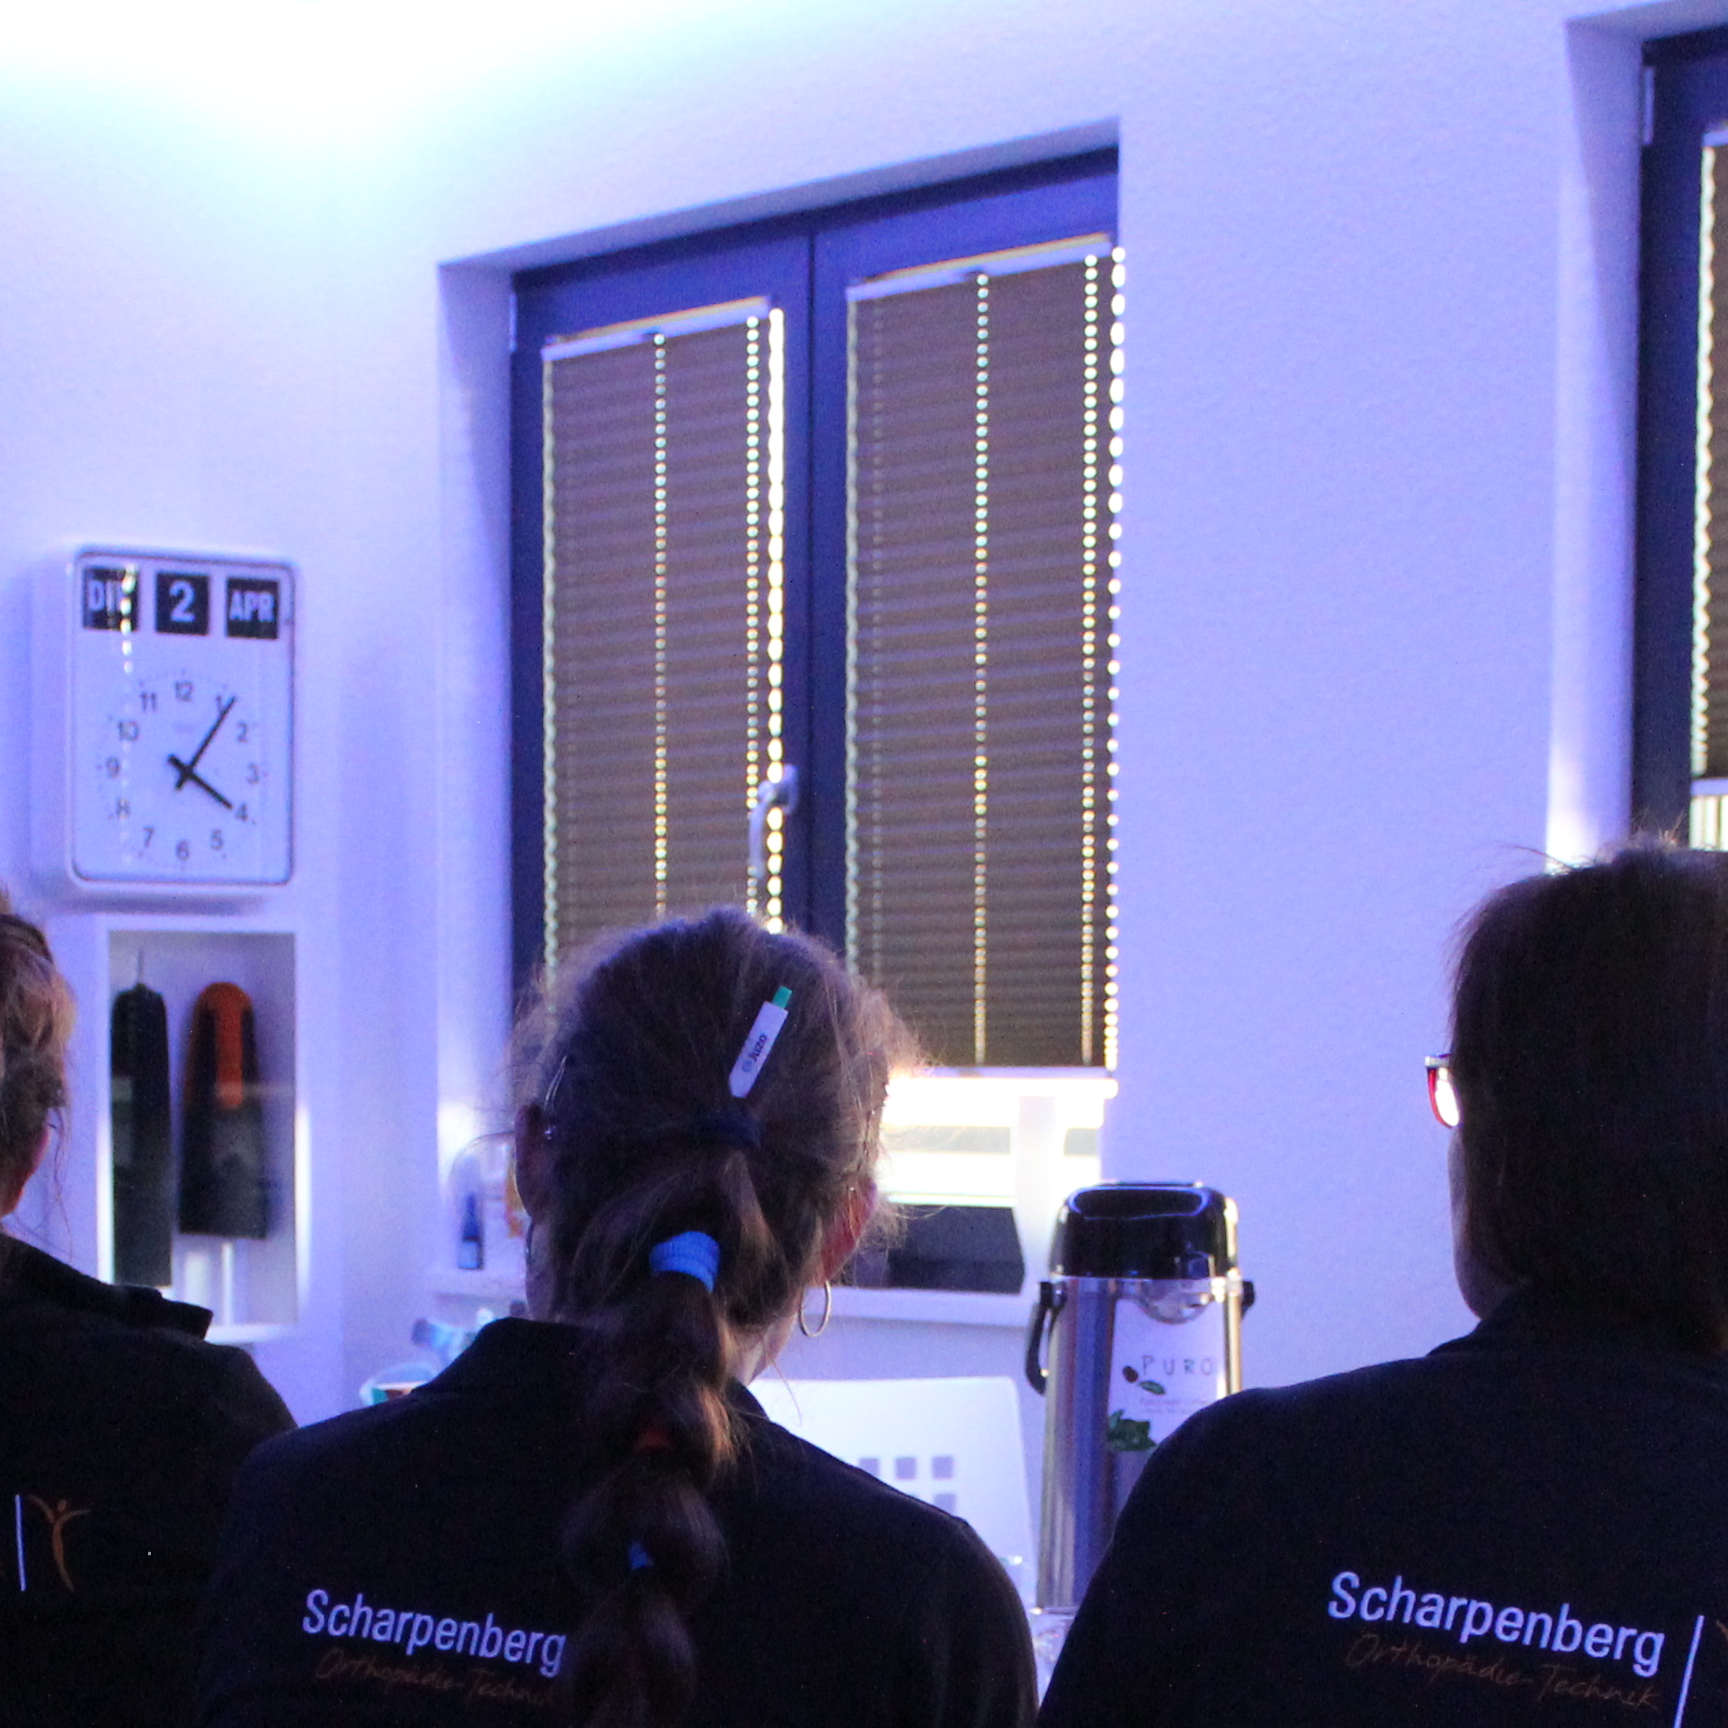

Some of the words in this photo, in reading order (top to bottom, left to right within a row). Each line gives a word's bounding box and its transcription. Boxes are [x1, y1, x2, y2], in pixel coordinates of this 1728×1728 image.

[169, 579, 196, 623] 2
[228, 591, 275, 622] APR
[140, 692, 157, 711] 11
[175, 682, 193, 701] 12
[118, 721, 139, 741] 10
[237, 722, 248, 743] 2
[106, 757, 120, 778] 9
[246, 762, 259, 784] 3
[235, 803, 249, 821] 4
[143, 826, 155, 847] 7
[210, 829, 224, 850] 5
[176, 840, 190, 861] 6
[1141, 1354, 1213, 1376] PURO
[301, 1588, 568, 1679] Scharpenberg
[1326, 1570, 1666, 1678] Scharpenberg
